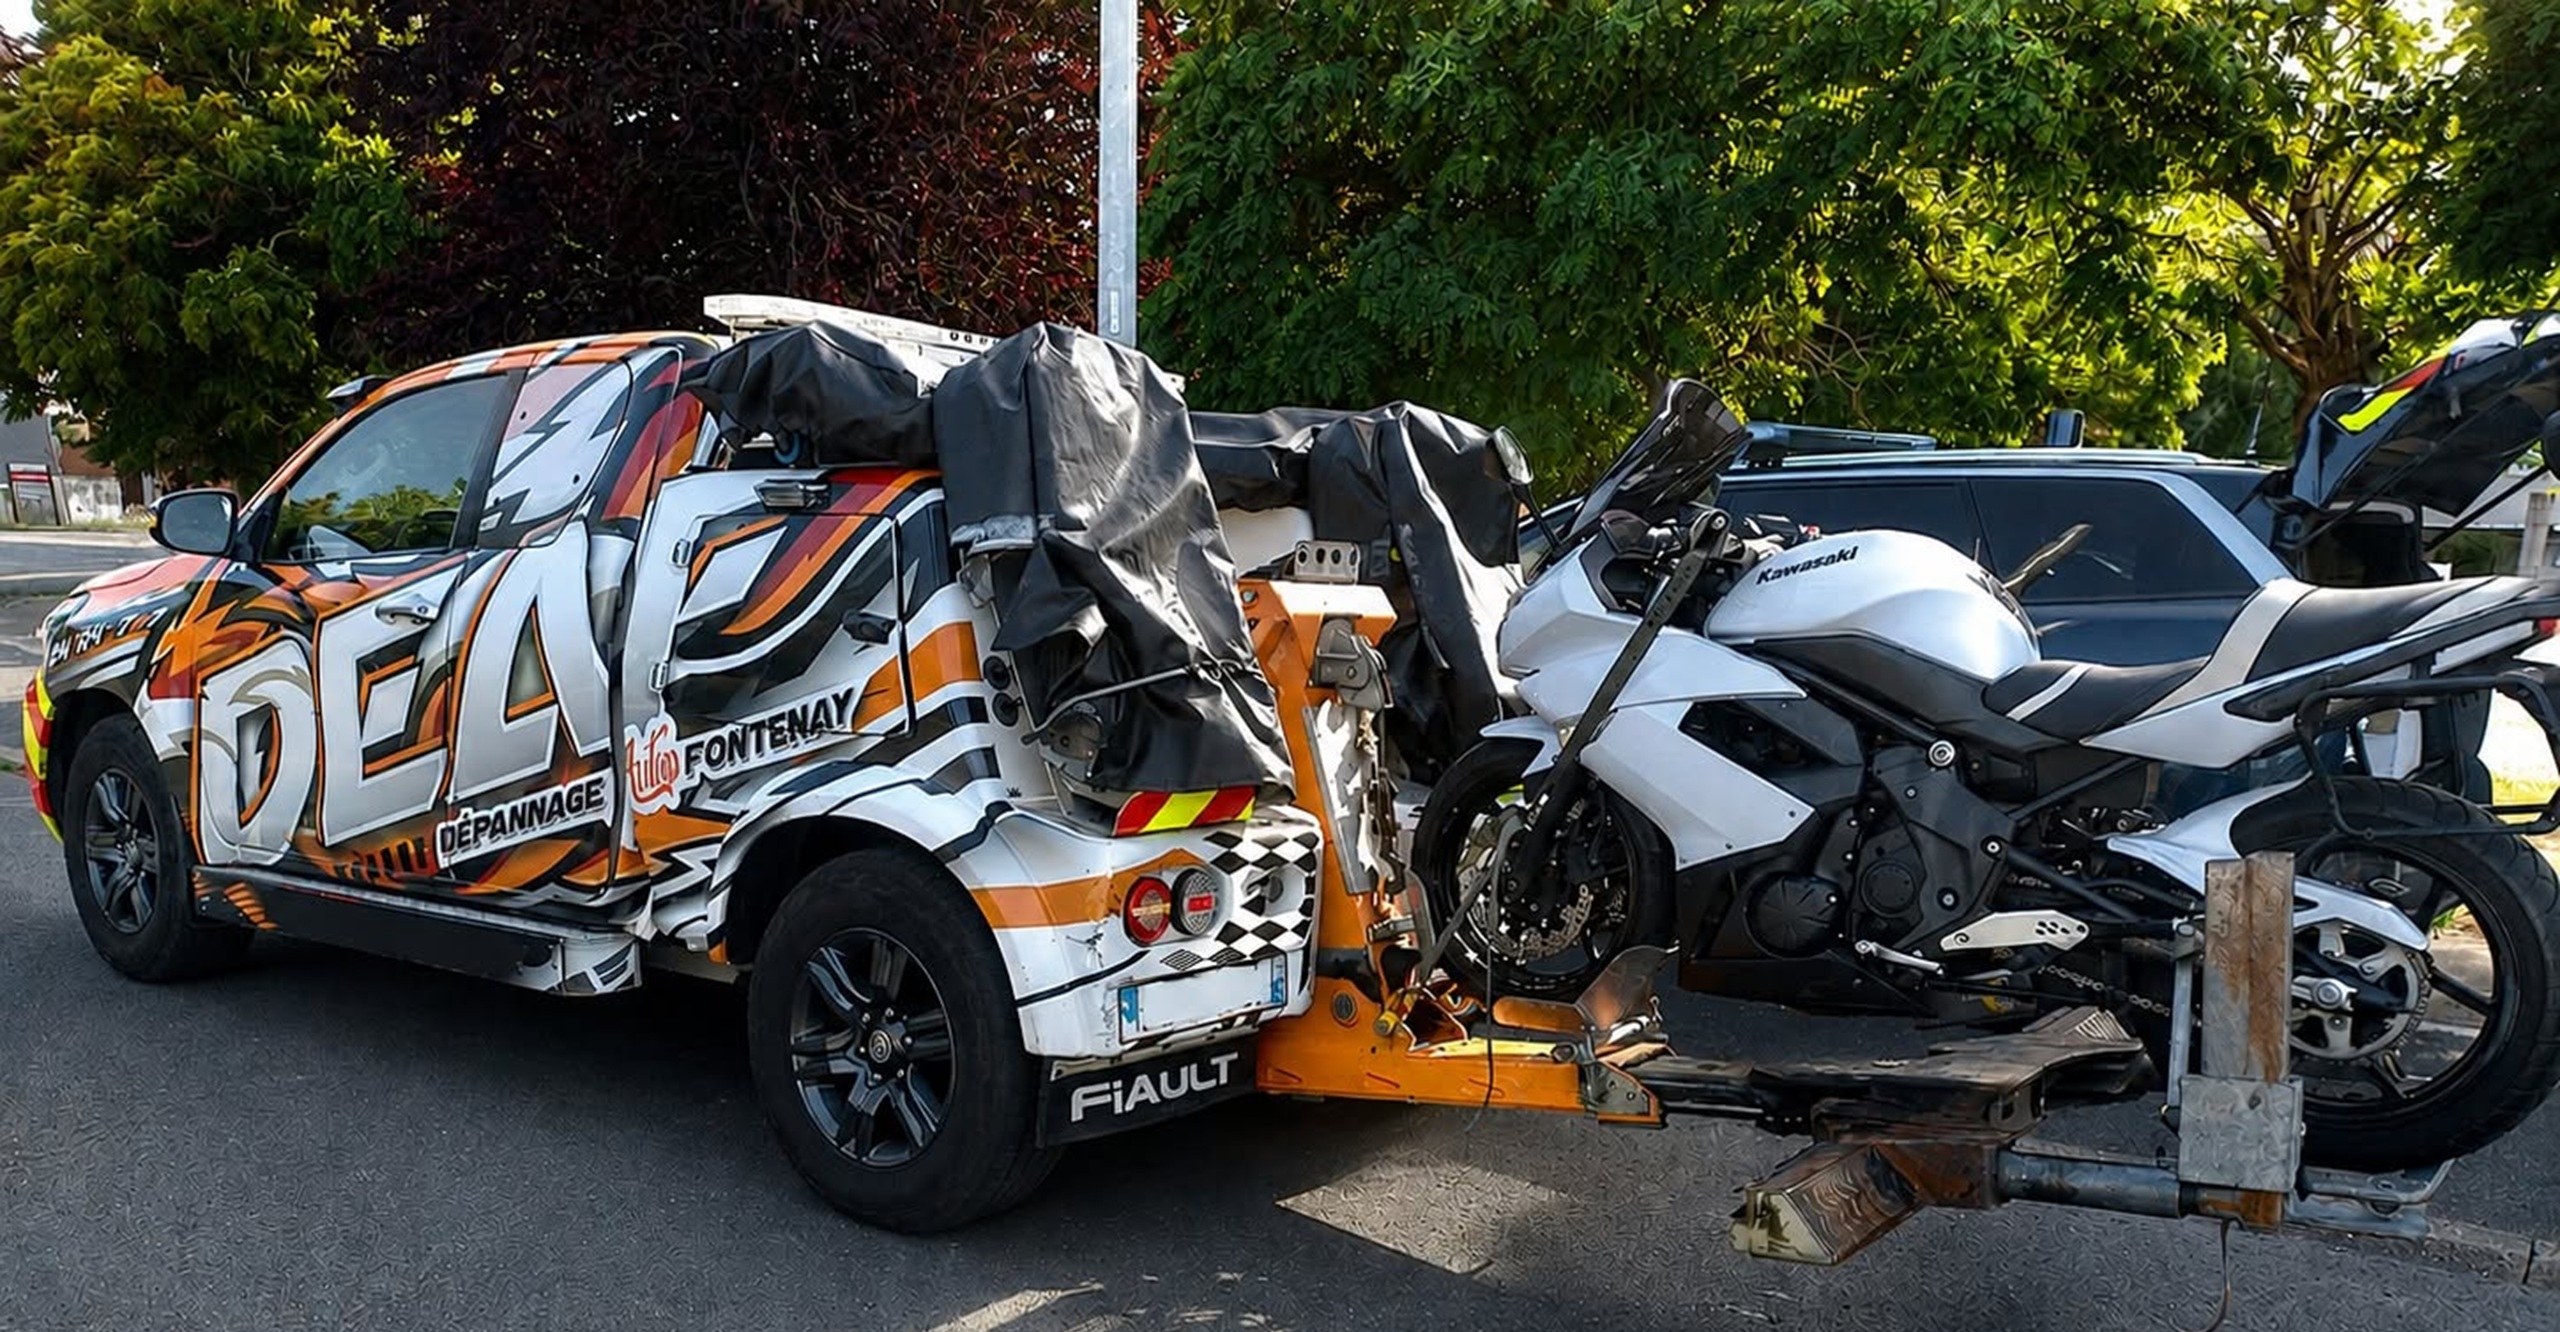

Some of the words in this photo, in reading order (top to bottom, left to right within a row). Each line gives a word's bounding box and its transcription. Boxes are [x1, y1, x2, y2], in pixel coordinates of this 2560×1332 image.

[1755, 545, 1859, 585] Kawasaki
[440, 779, 604, 855] DÉPANNAGE
[684, 689, 854, 779] FONTENAY
